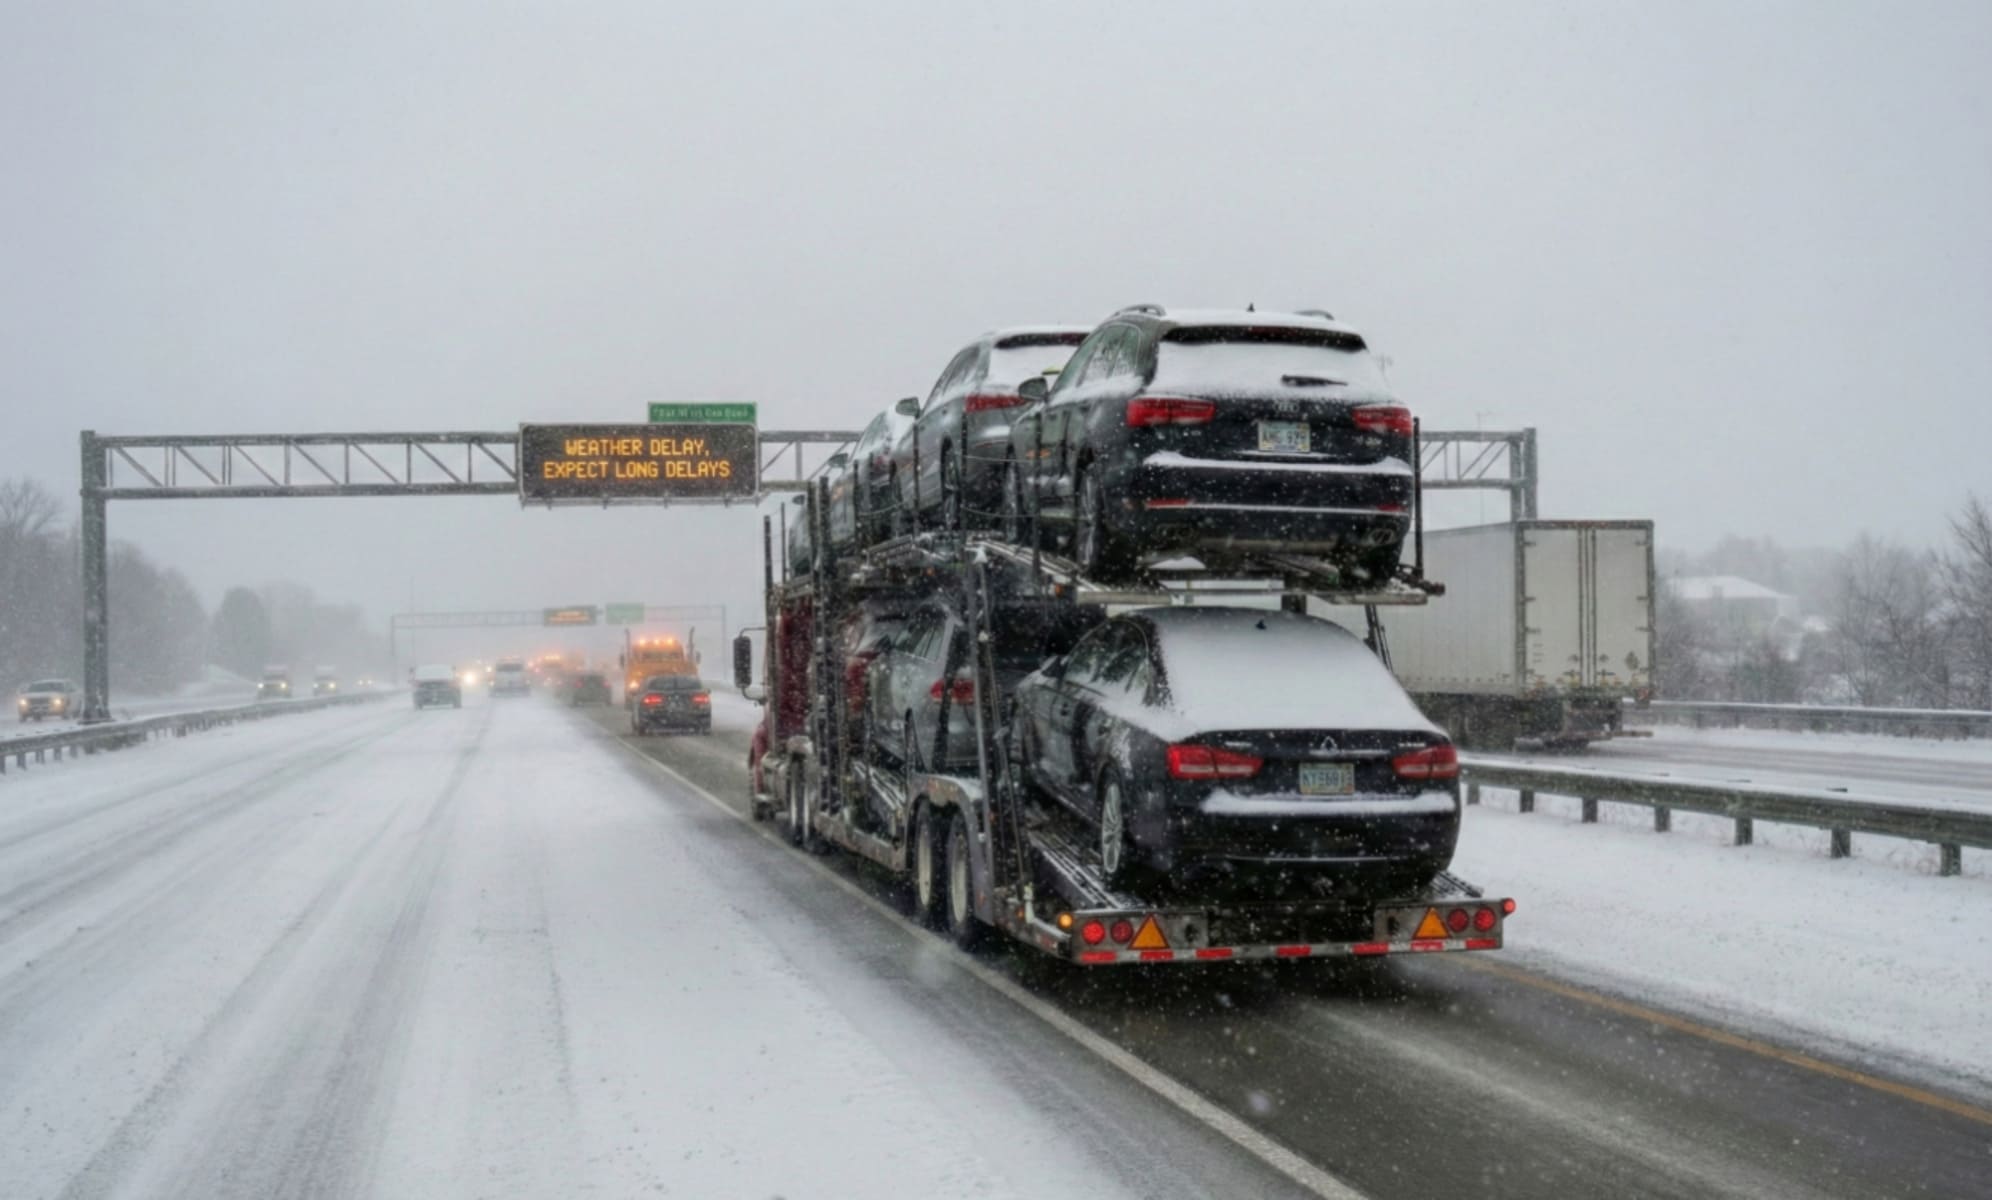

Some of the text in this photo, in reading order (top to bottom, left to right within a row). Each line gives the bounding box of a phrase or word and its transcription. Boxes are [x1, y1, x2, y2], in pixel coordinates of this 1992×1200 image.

[565, 439, 642, 456] WEATHER
[543, 461, 730, 478] EXPECT LONG DELAYS
